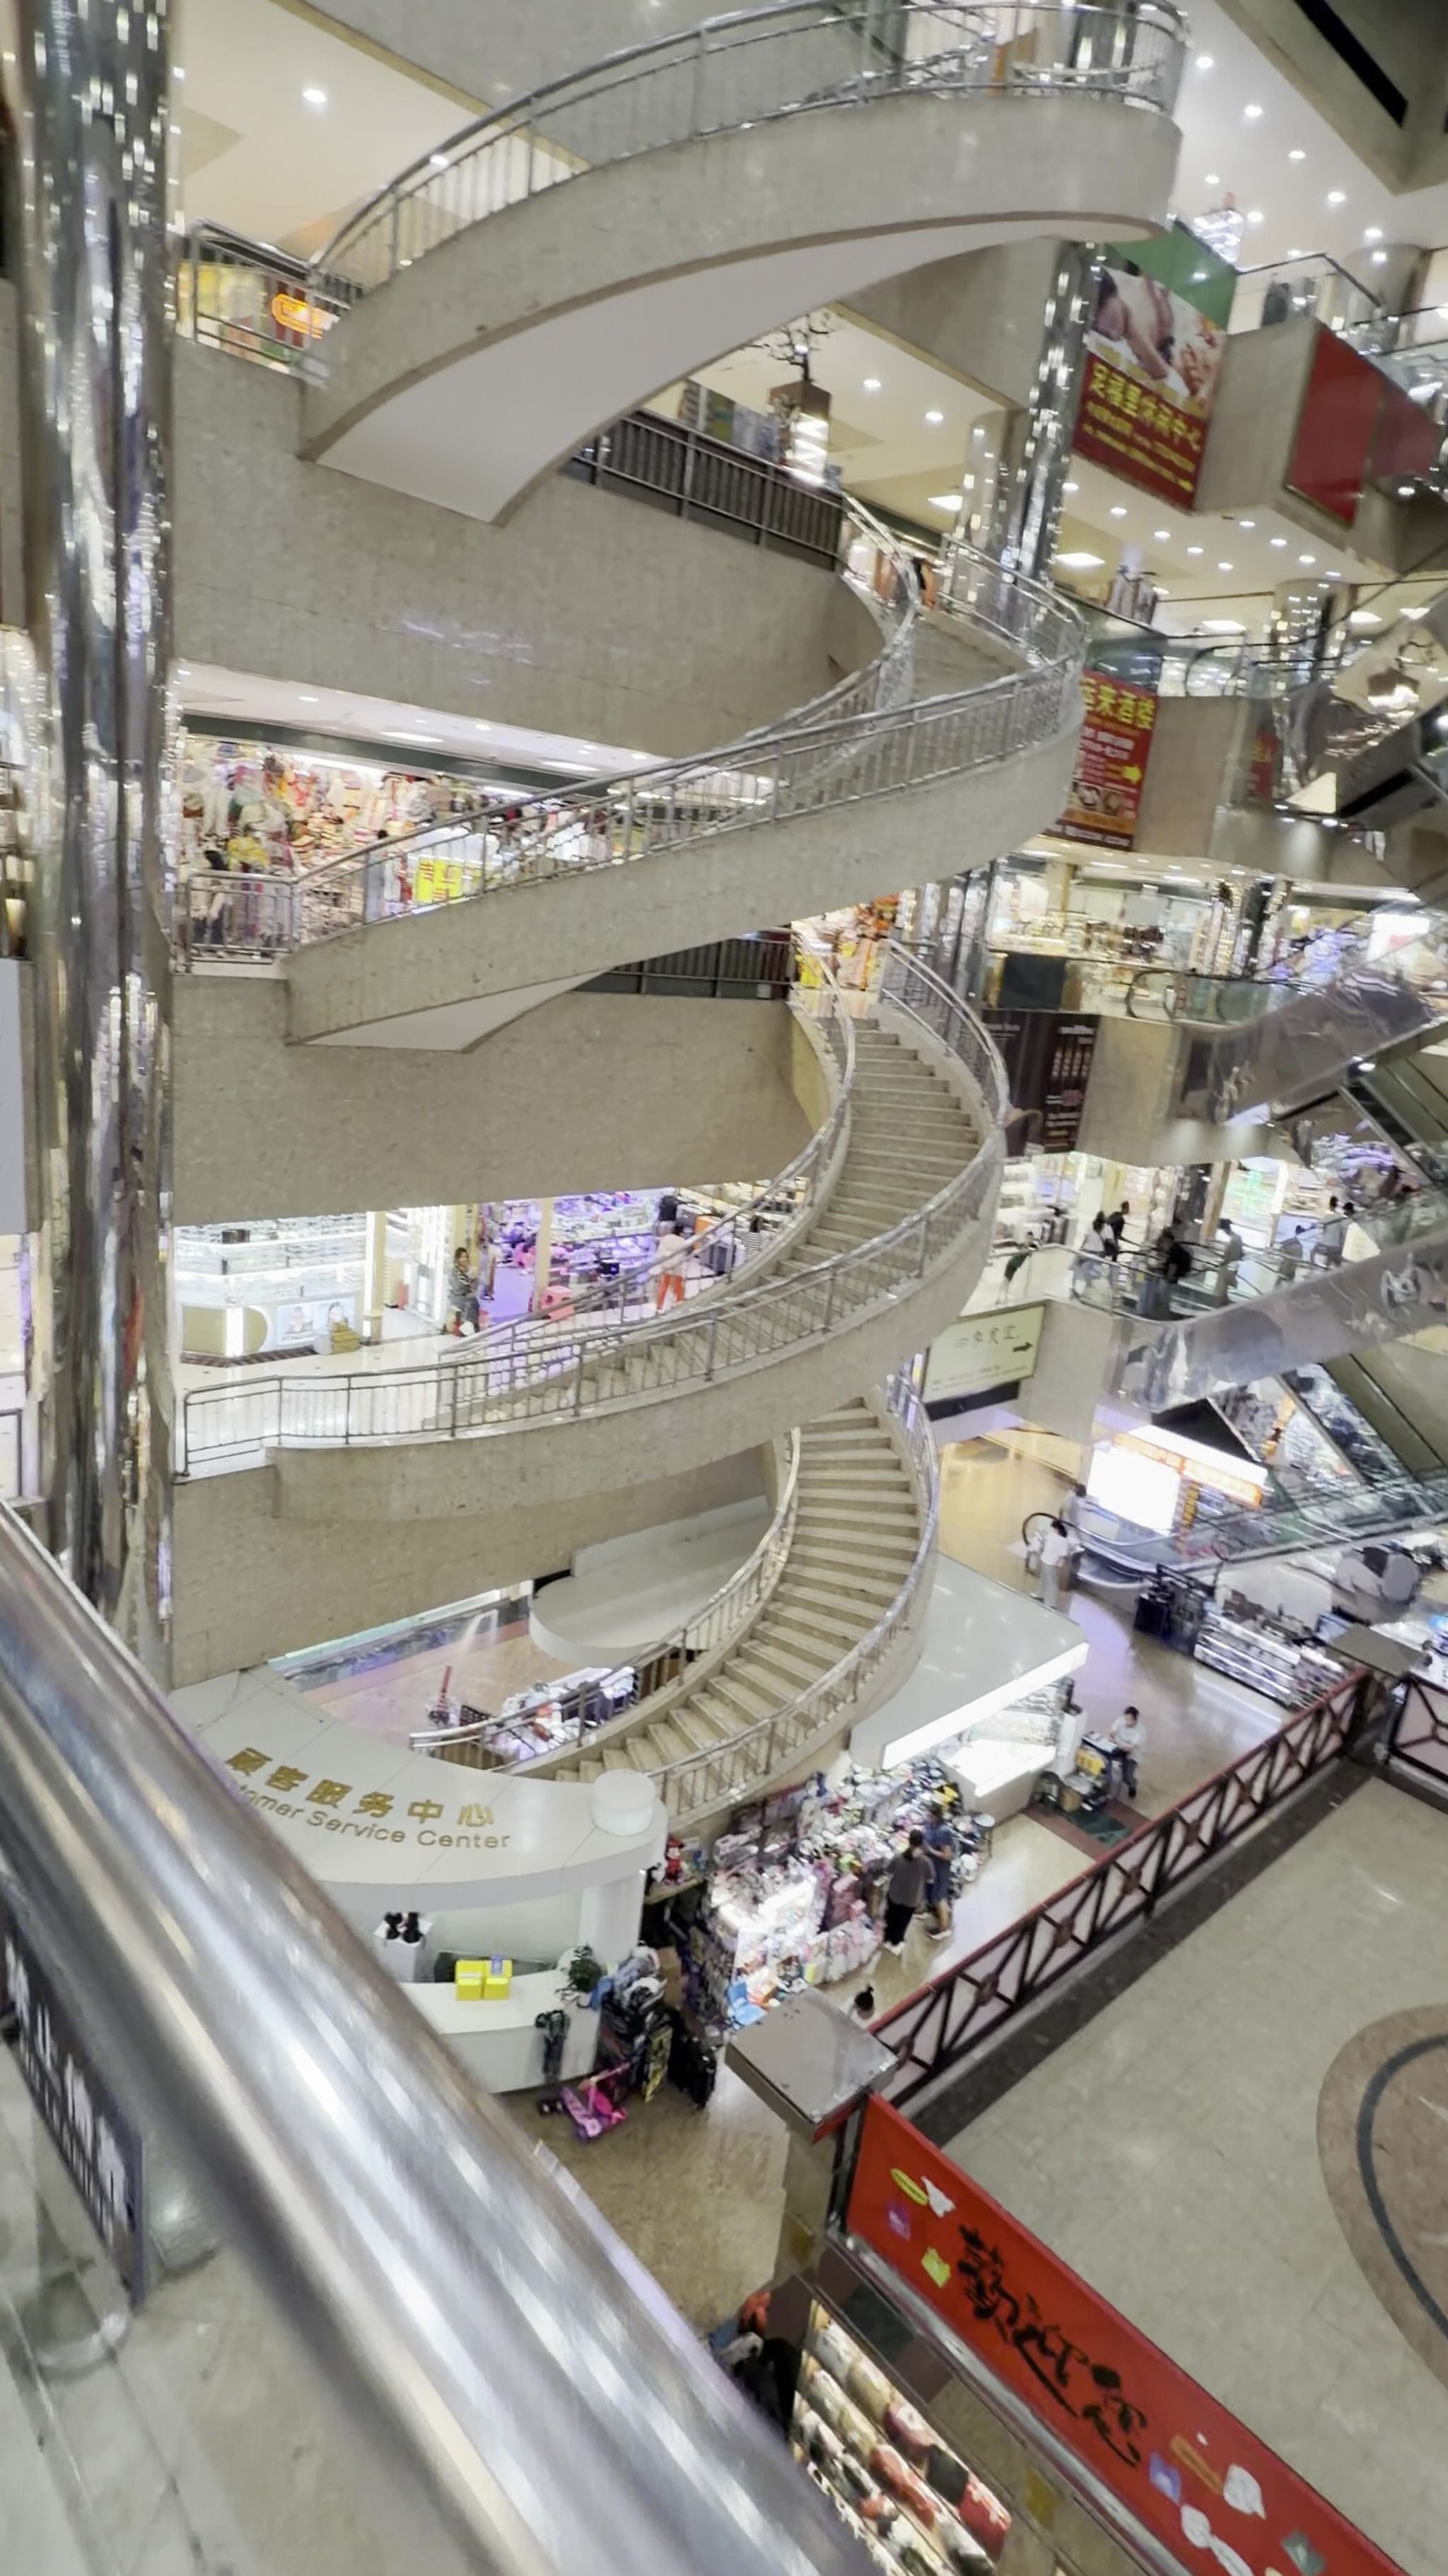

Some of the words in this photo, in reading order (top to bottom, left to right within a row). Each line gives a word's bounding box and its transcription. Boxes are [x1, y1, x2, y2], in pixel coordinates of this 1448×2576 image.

[225, 1747, 494, 1826] 顾客服务中心
[307, 1811, 405, 1843] Service
[418, 1830, 510, 1848] Center
